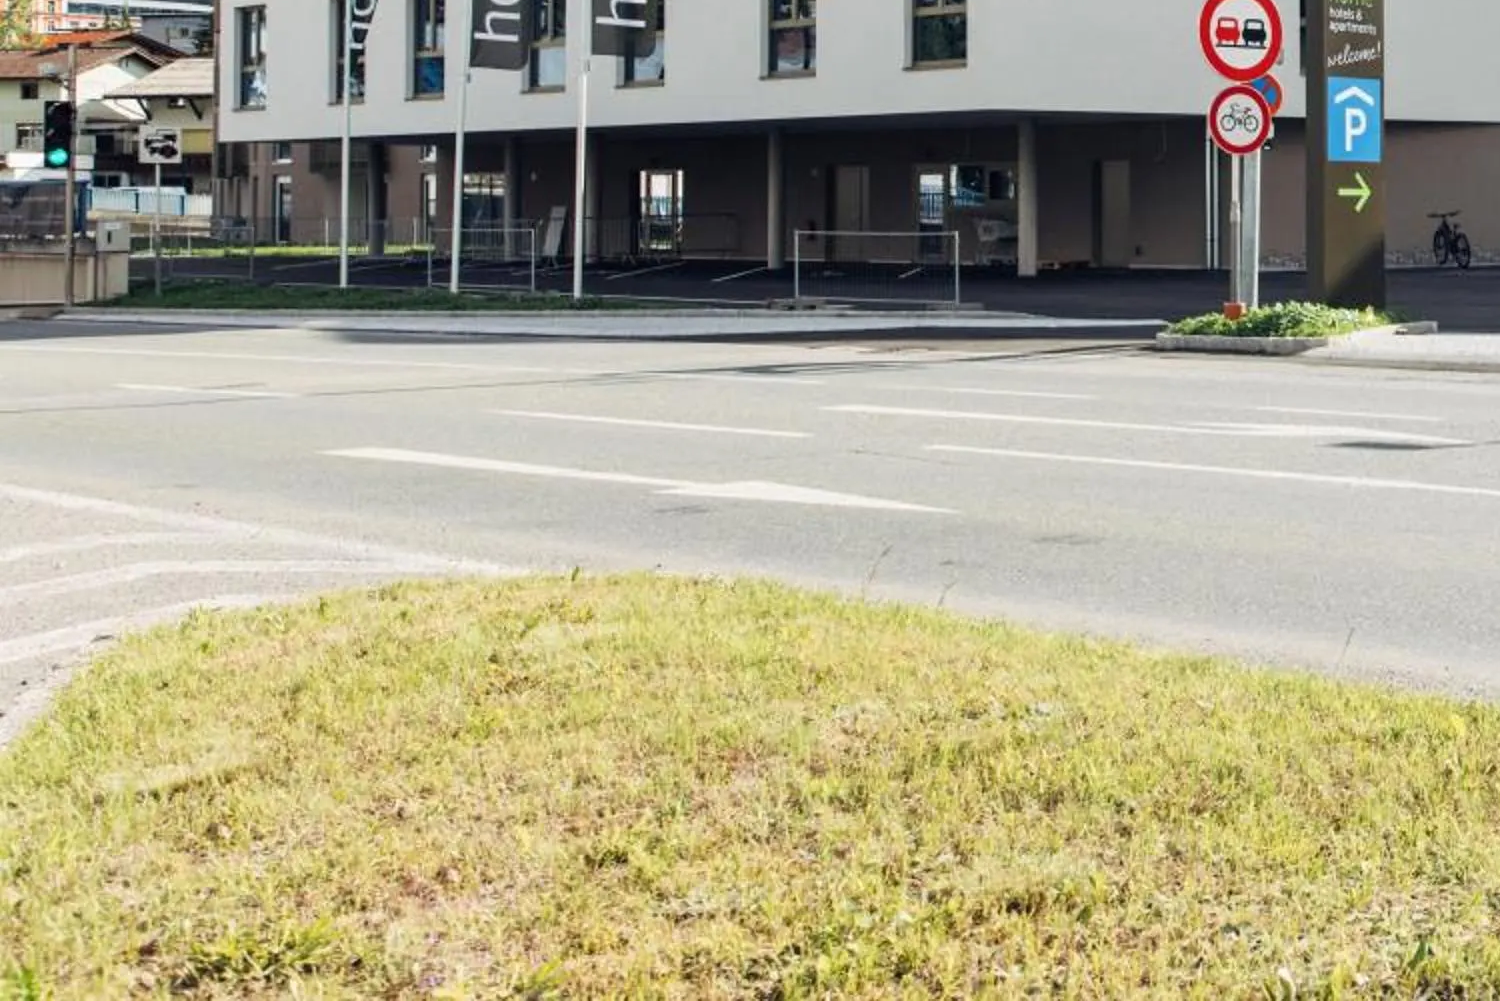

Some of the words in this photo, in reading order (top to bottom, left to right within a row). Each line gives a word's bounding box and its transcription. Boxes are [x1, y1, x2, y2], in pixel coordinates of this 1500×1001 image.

[1329, 6, 1355, 20] hotels
[1329, 21, 1378, 36] apartments
[1327, 40, 1382, 68] welcome!
[1344, 108, 1367, 152] P
